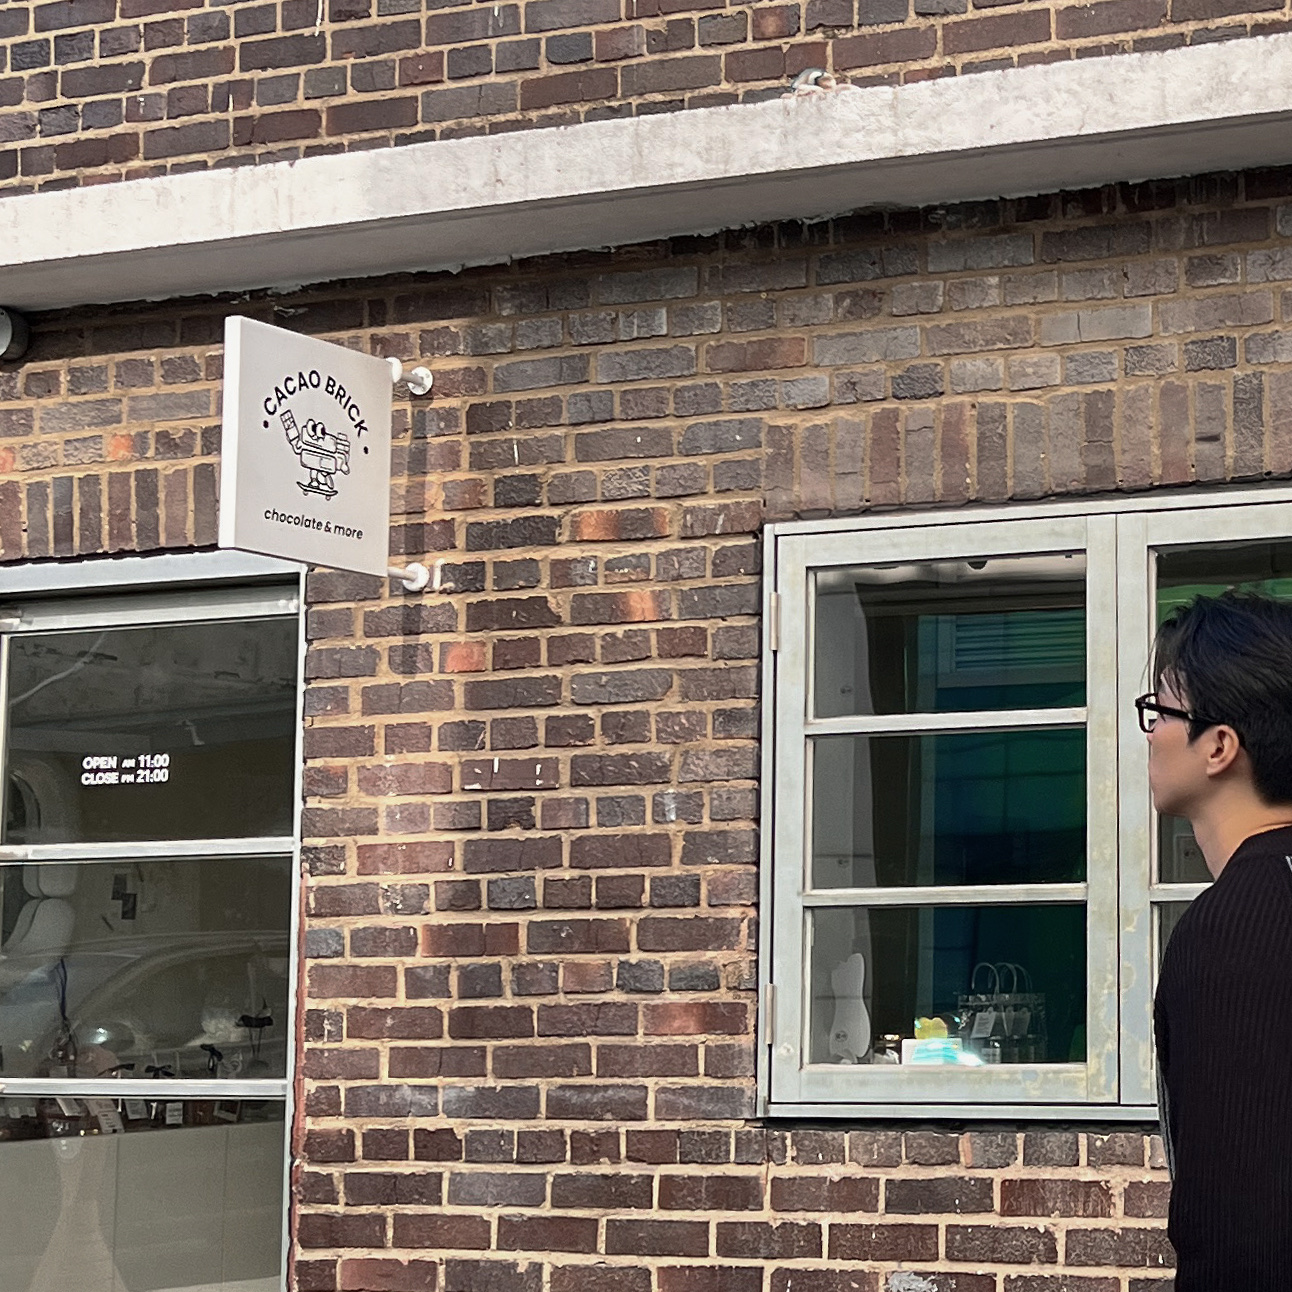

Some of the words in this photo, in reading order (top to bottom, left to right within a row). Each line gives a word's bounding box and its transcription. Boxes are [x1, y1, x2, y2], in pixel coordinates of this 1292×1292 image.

[264, 370, 321, 416] CACAO
[324, 375, 369, 437] BRICK
[264, 508, 323, 531] chocolate
[324, 522, 332, 533] &
[333, 526, 364, 540] more
[82, 756, 118, 769] OPEN
[121, 758, 136, 768] AM
[138, 753, 170, 768] 11:00
[81, 772, 119, 785] CLOSE
[121, 774, 135, 783] PM
[136, 768, 169, 782] 21:00
